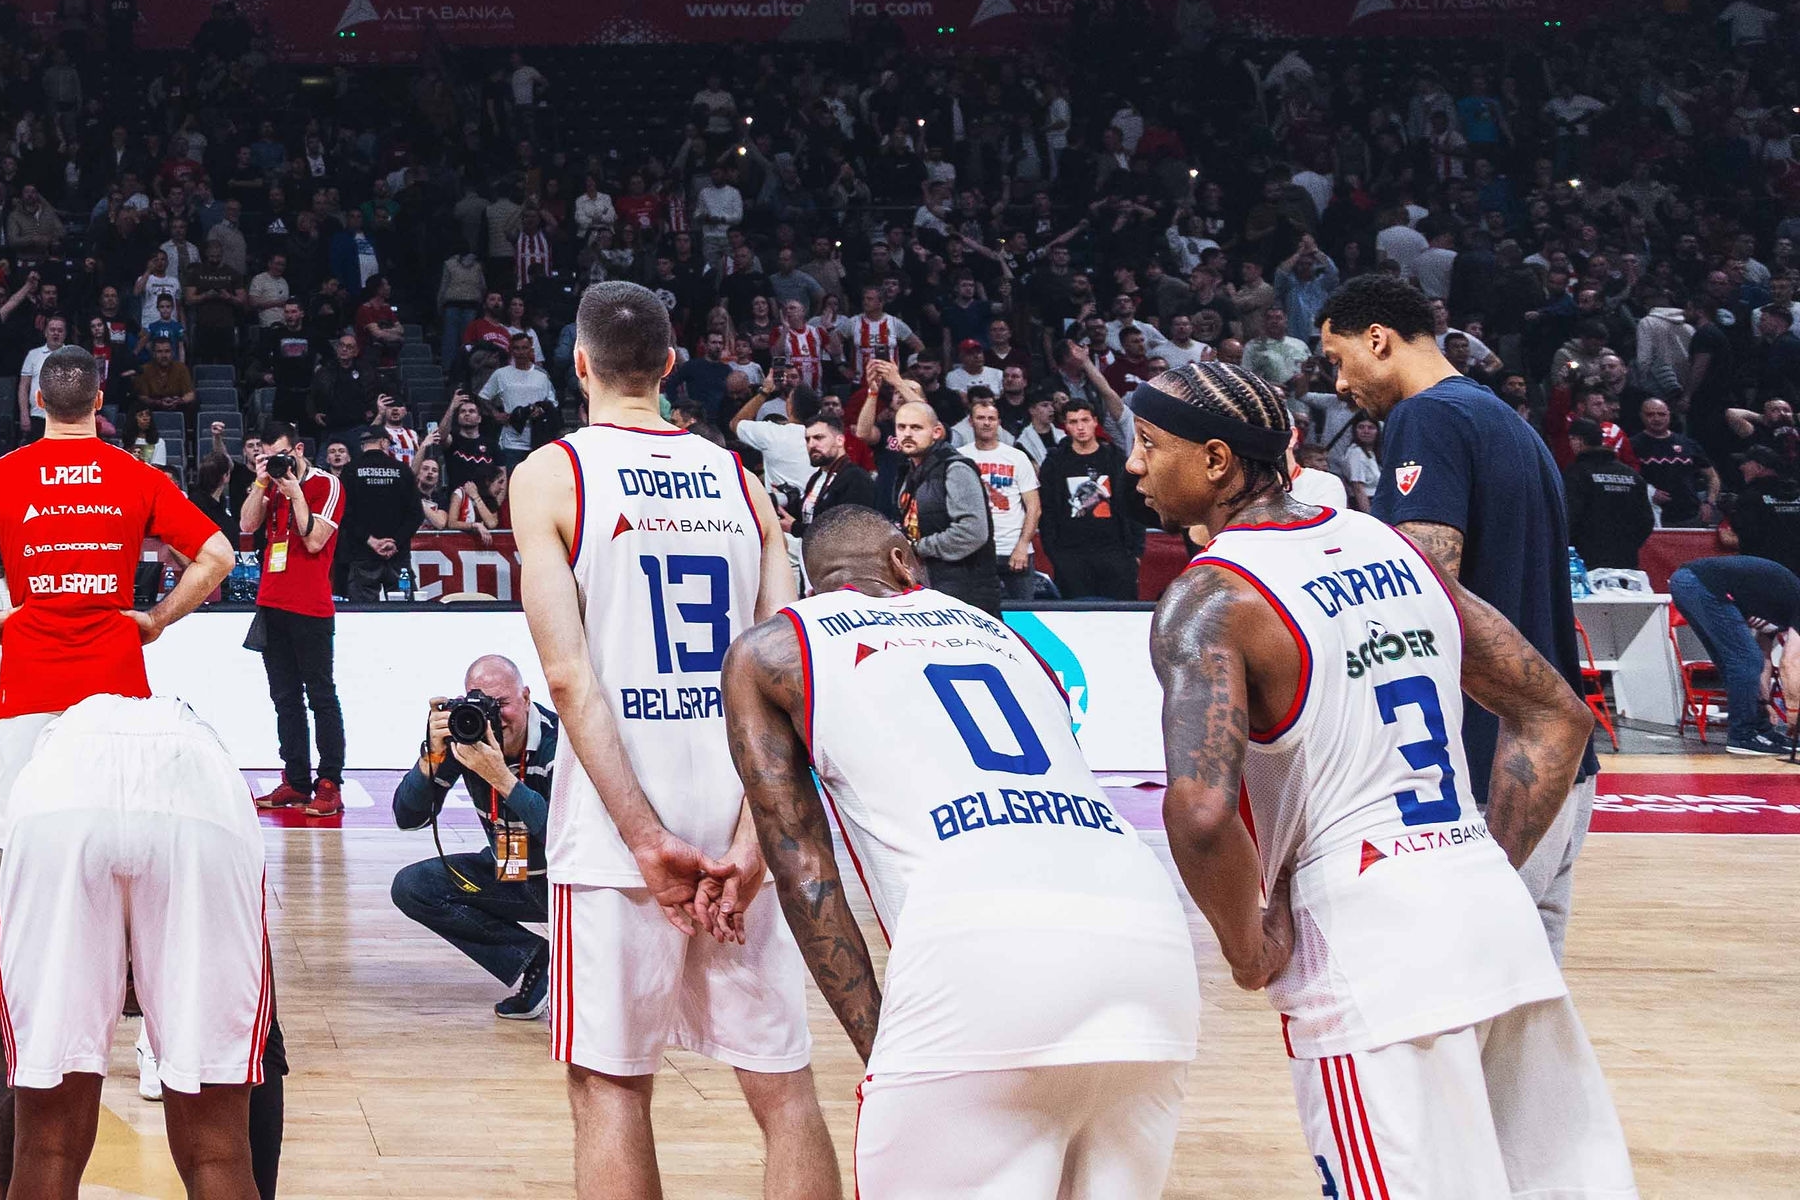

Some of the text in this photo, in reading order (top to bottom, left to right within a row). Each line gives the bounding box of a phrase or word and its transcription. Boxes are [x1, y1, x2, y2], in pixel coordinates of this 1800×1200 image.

[383, 6, 514, 20] ALTABANKA
[40, 461, 102, 485] LAZIĆ
[617, 465, 721, 499] DOBRIĆ
[41, 505, 123, 517] ALTABANKA
[637, 518, 745, 536] ALTABANKA
[54, 543, 99, 551] CONCORD
[100, 543, 124, 551] WEST
[28, 574, 119, 595] BELGRADE
[639, 554, 731, 674] 13
[884, 638, 1022, 664] ALTABANKA
[620, 686, 724, 720] BELGRA
[1375, 675, 1462, 826] 3
[930, 788, 1125, 841] BELGRADE
[1395, 828, 1488, 856] ALTABANK
